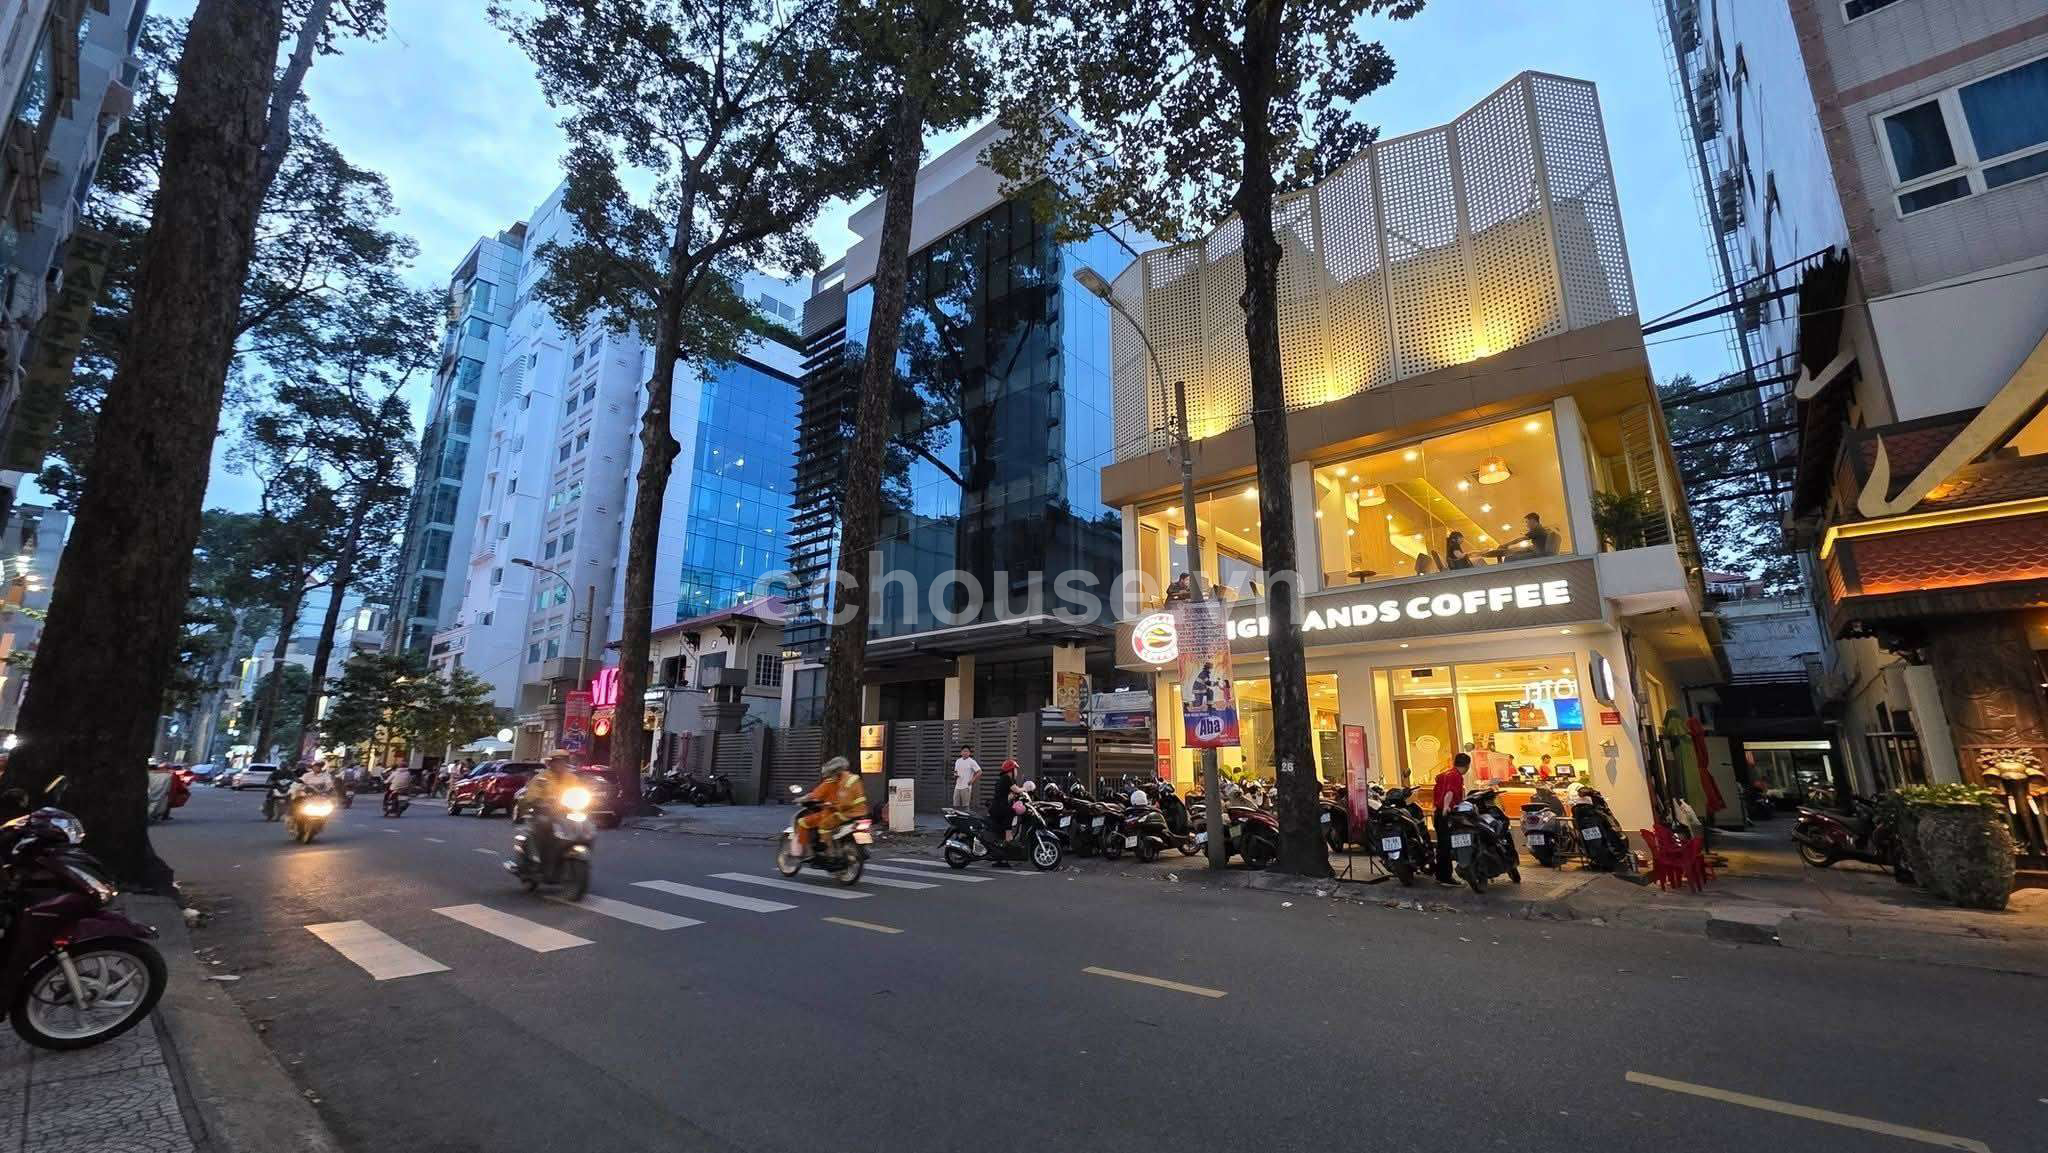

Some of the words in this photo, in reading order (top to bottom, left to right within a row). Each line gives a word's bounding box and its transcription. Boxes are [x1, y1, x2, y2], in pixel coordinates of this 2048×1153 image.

[1226, 599, 1400, 641] IGANDS
[1405, 579, 1571, 620] COFFEE
[1199, 718, 1221, 737] Aba
[1281, 761, 1294, 773] 26
